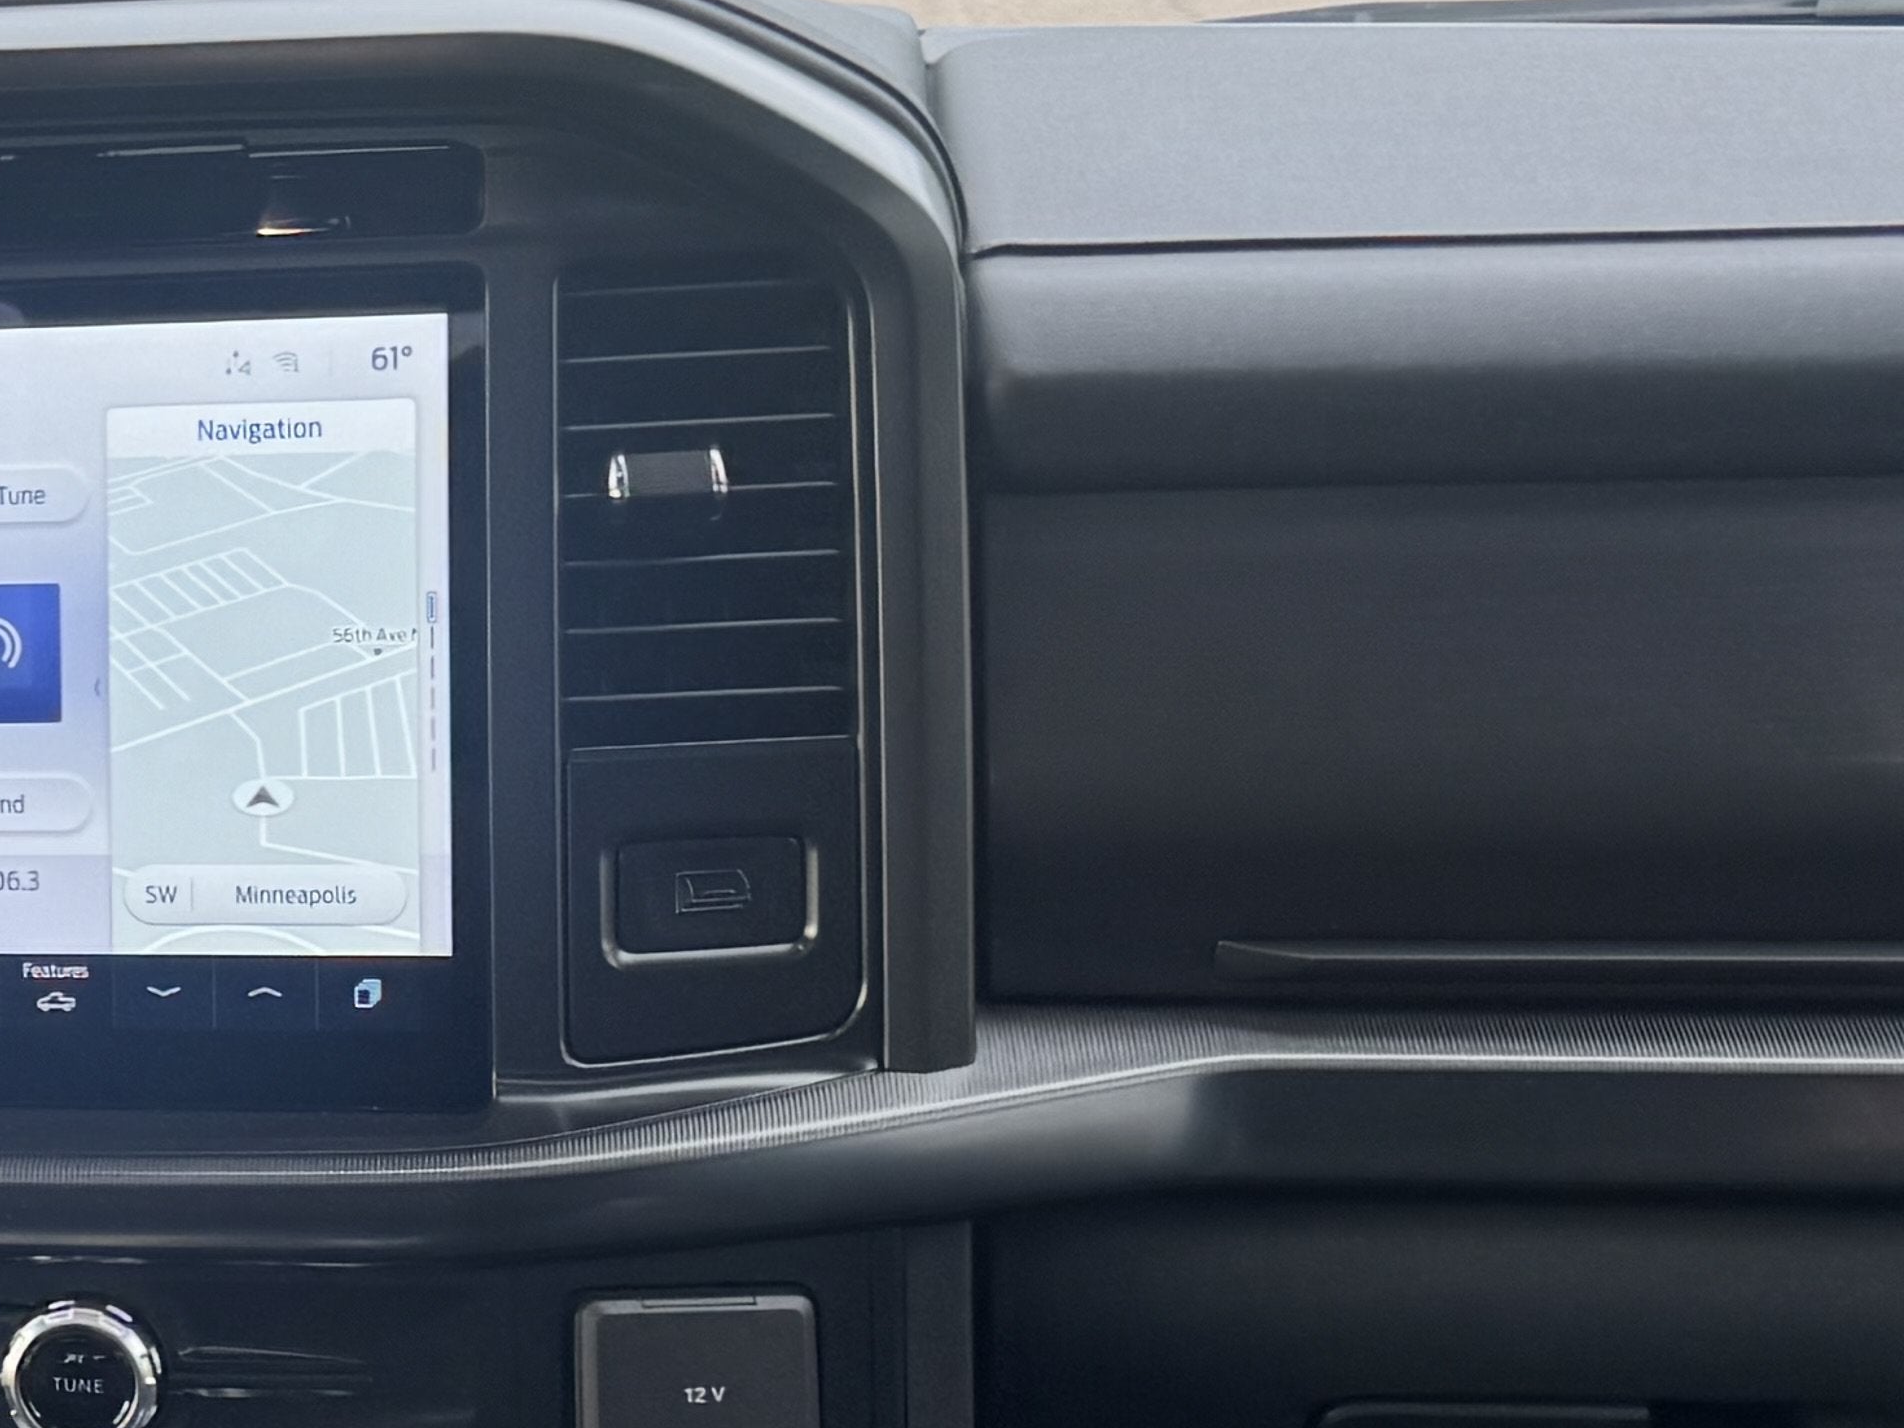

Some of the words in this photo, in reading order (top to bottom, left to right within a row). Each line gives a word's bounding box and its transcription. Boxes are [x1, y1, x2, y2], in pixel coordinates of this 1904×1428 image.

[370, 345, 412, 371] 61°
[196, 417, 323, 445] Navigation
[145, 886, 178, 905] SW
[235, 884, 357, 909] Minneapolis
[22, 961, 90, 980] Features
[52, 1376, 104, 1395] TUNE
[684, 1386, 706, 1404] 12
[710, 1386, 726, 1404] V
